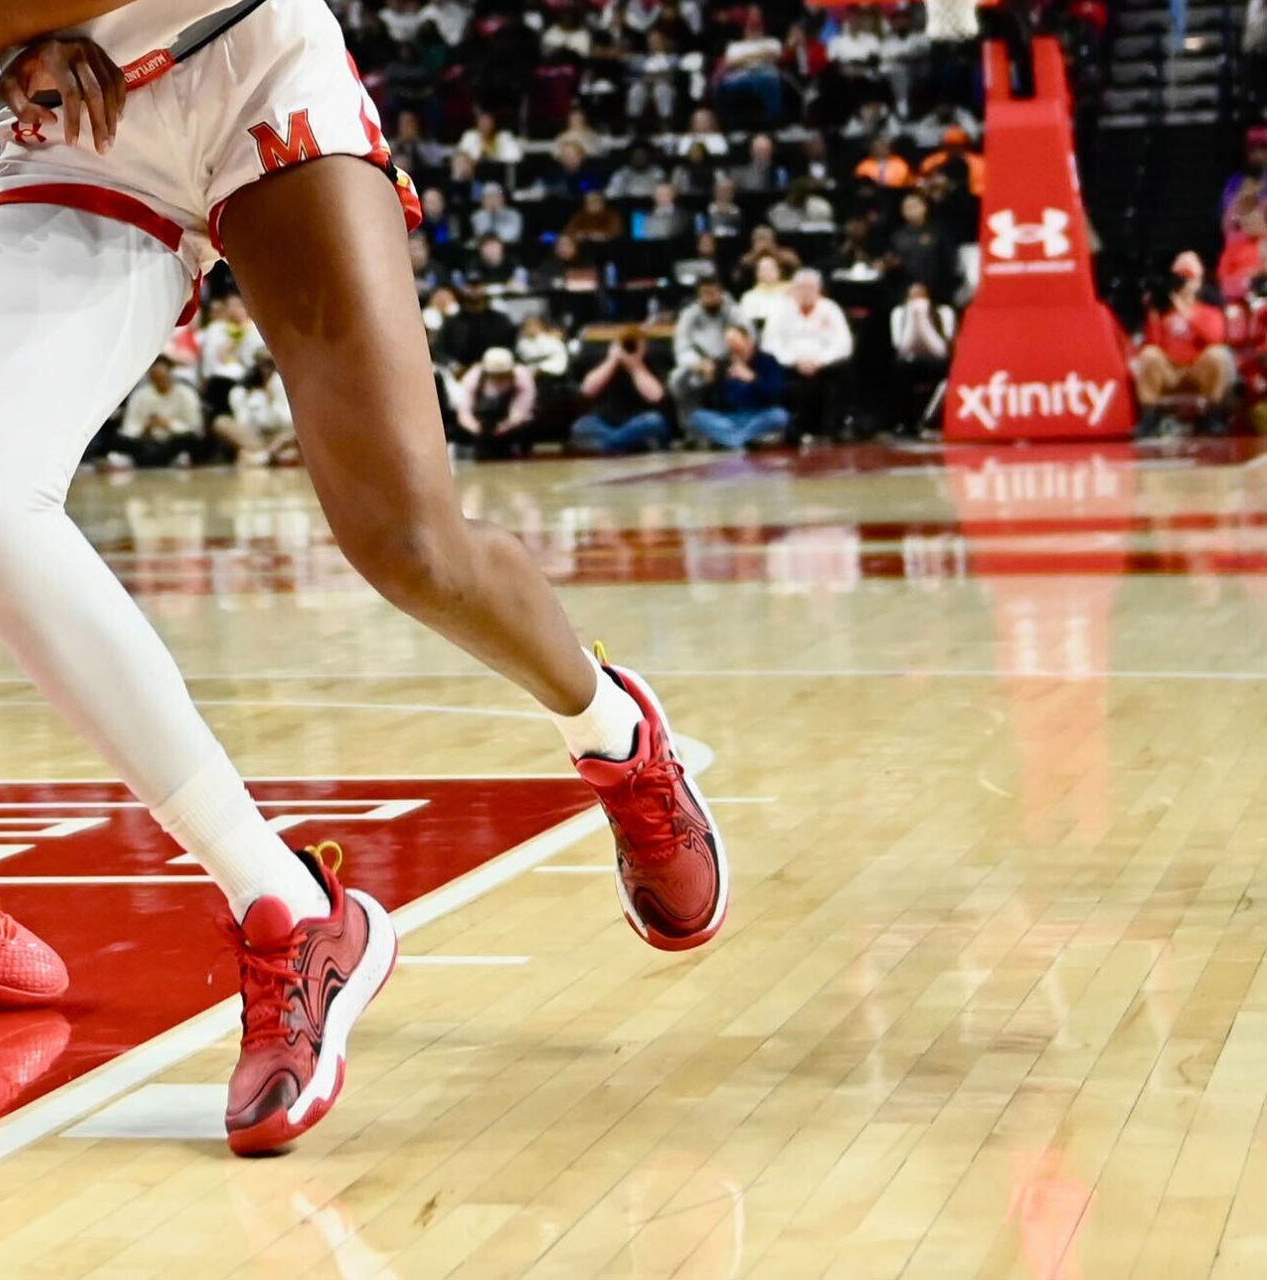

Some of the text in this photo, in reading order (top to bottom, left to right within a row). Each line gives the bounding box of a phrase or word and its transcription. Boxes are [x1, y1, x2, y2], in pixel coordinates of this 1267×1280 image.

[124, 53, 166, 83] MARYLAND
[248, 108, 322, 174] M
[957, 371, 1118, 430] xfinity
